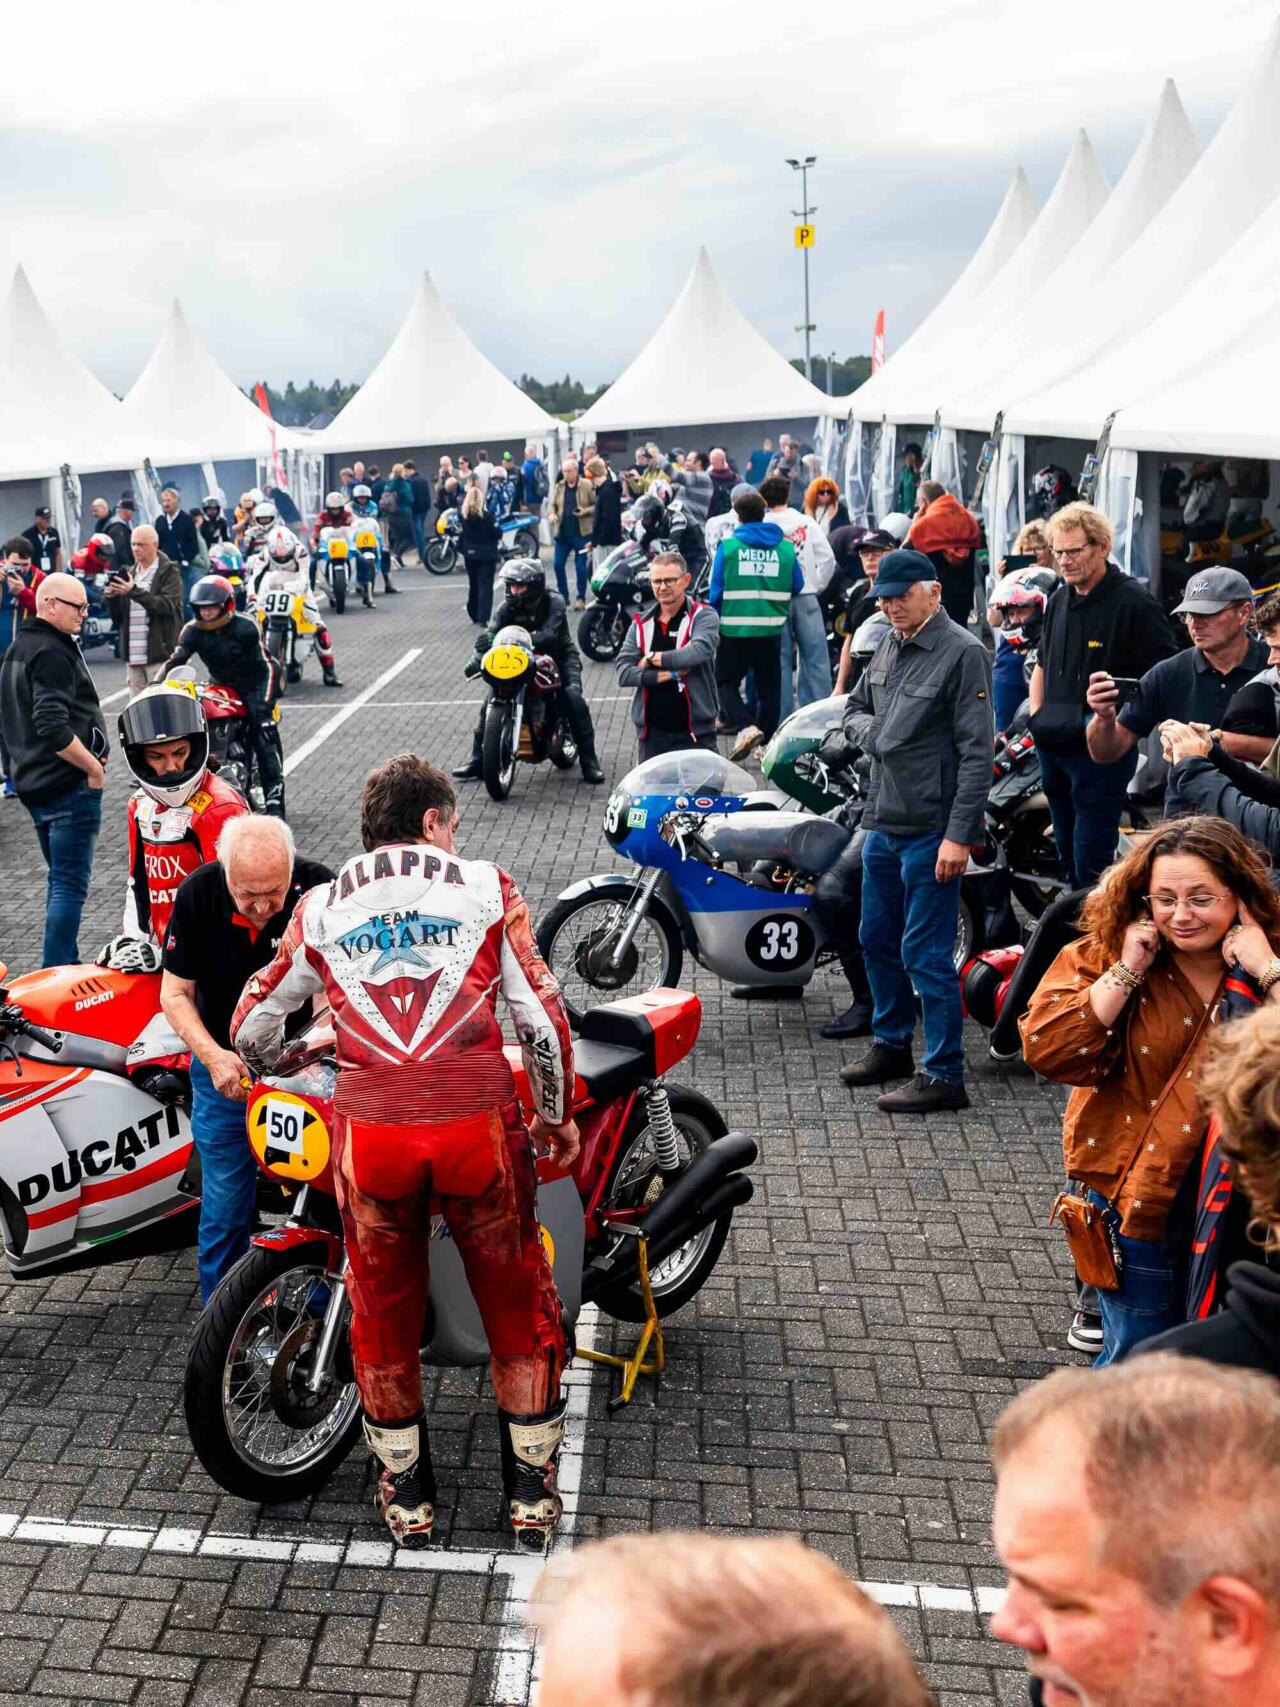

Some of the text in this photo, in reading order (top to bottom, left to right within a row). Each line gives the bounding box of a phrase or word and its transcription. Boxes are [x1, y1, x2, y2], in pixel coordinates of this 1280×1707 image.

[800, 229, 810, 245] P
[738, 548, 780, 561] MEDIA
[753, 563, 765, 574] 12
[265, 594, 290, 612] 99
[603, 793, 624, 834] 33
[632, 812, 642, 821] 33
[369, 909, 420, 928] TEAM
[340, 924, 460, 960] VOGART
[760, 921, 798, 960] 33
[74, 990, 115, 1012] DUCATI
[270, 1111, 298, 1142] 50
[17, 1105, 181, 1207] DUCATI
